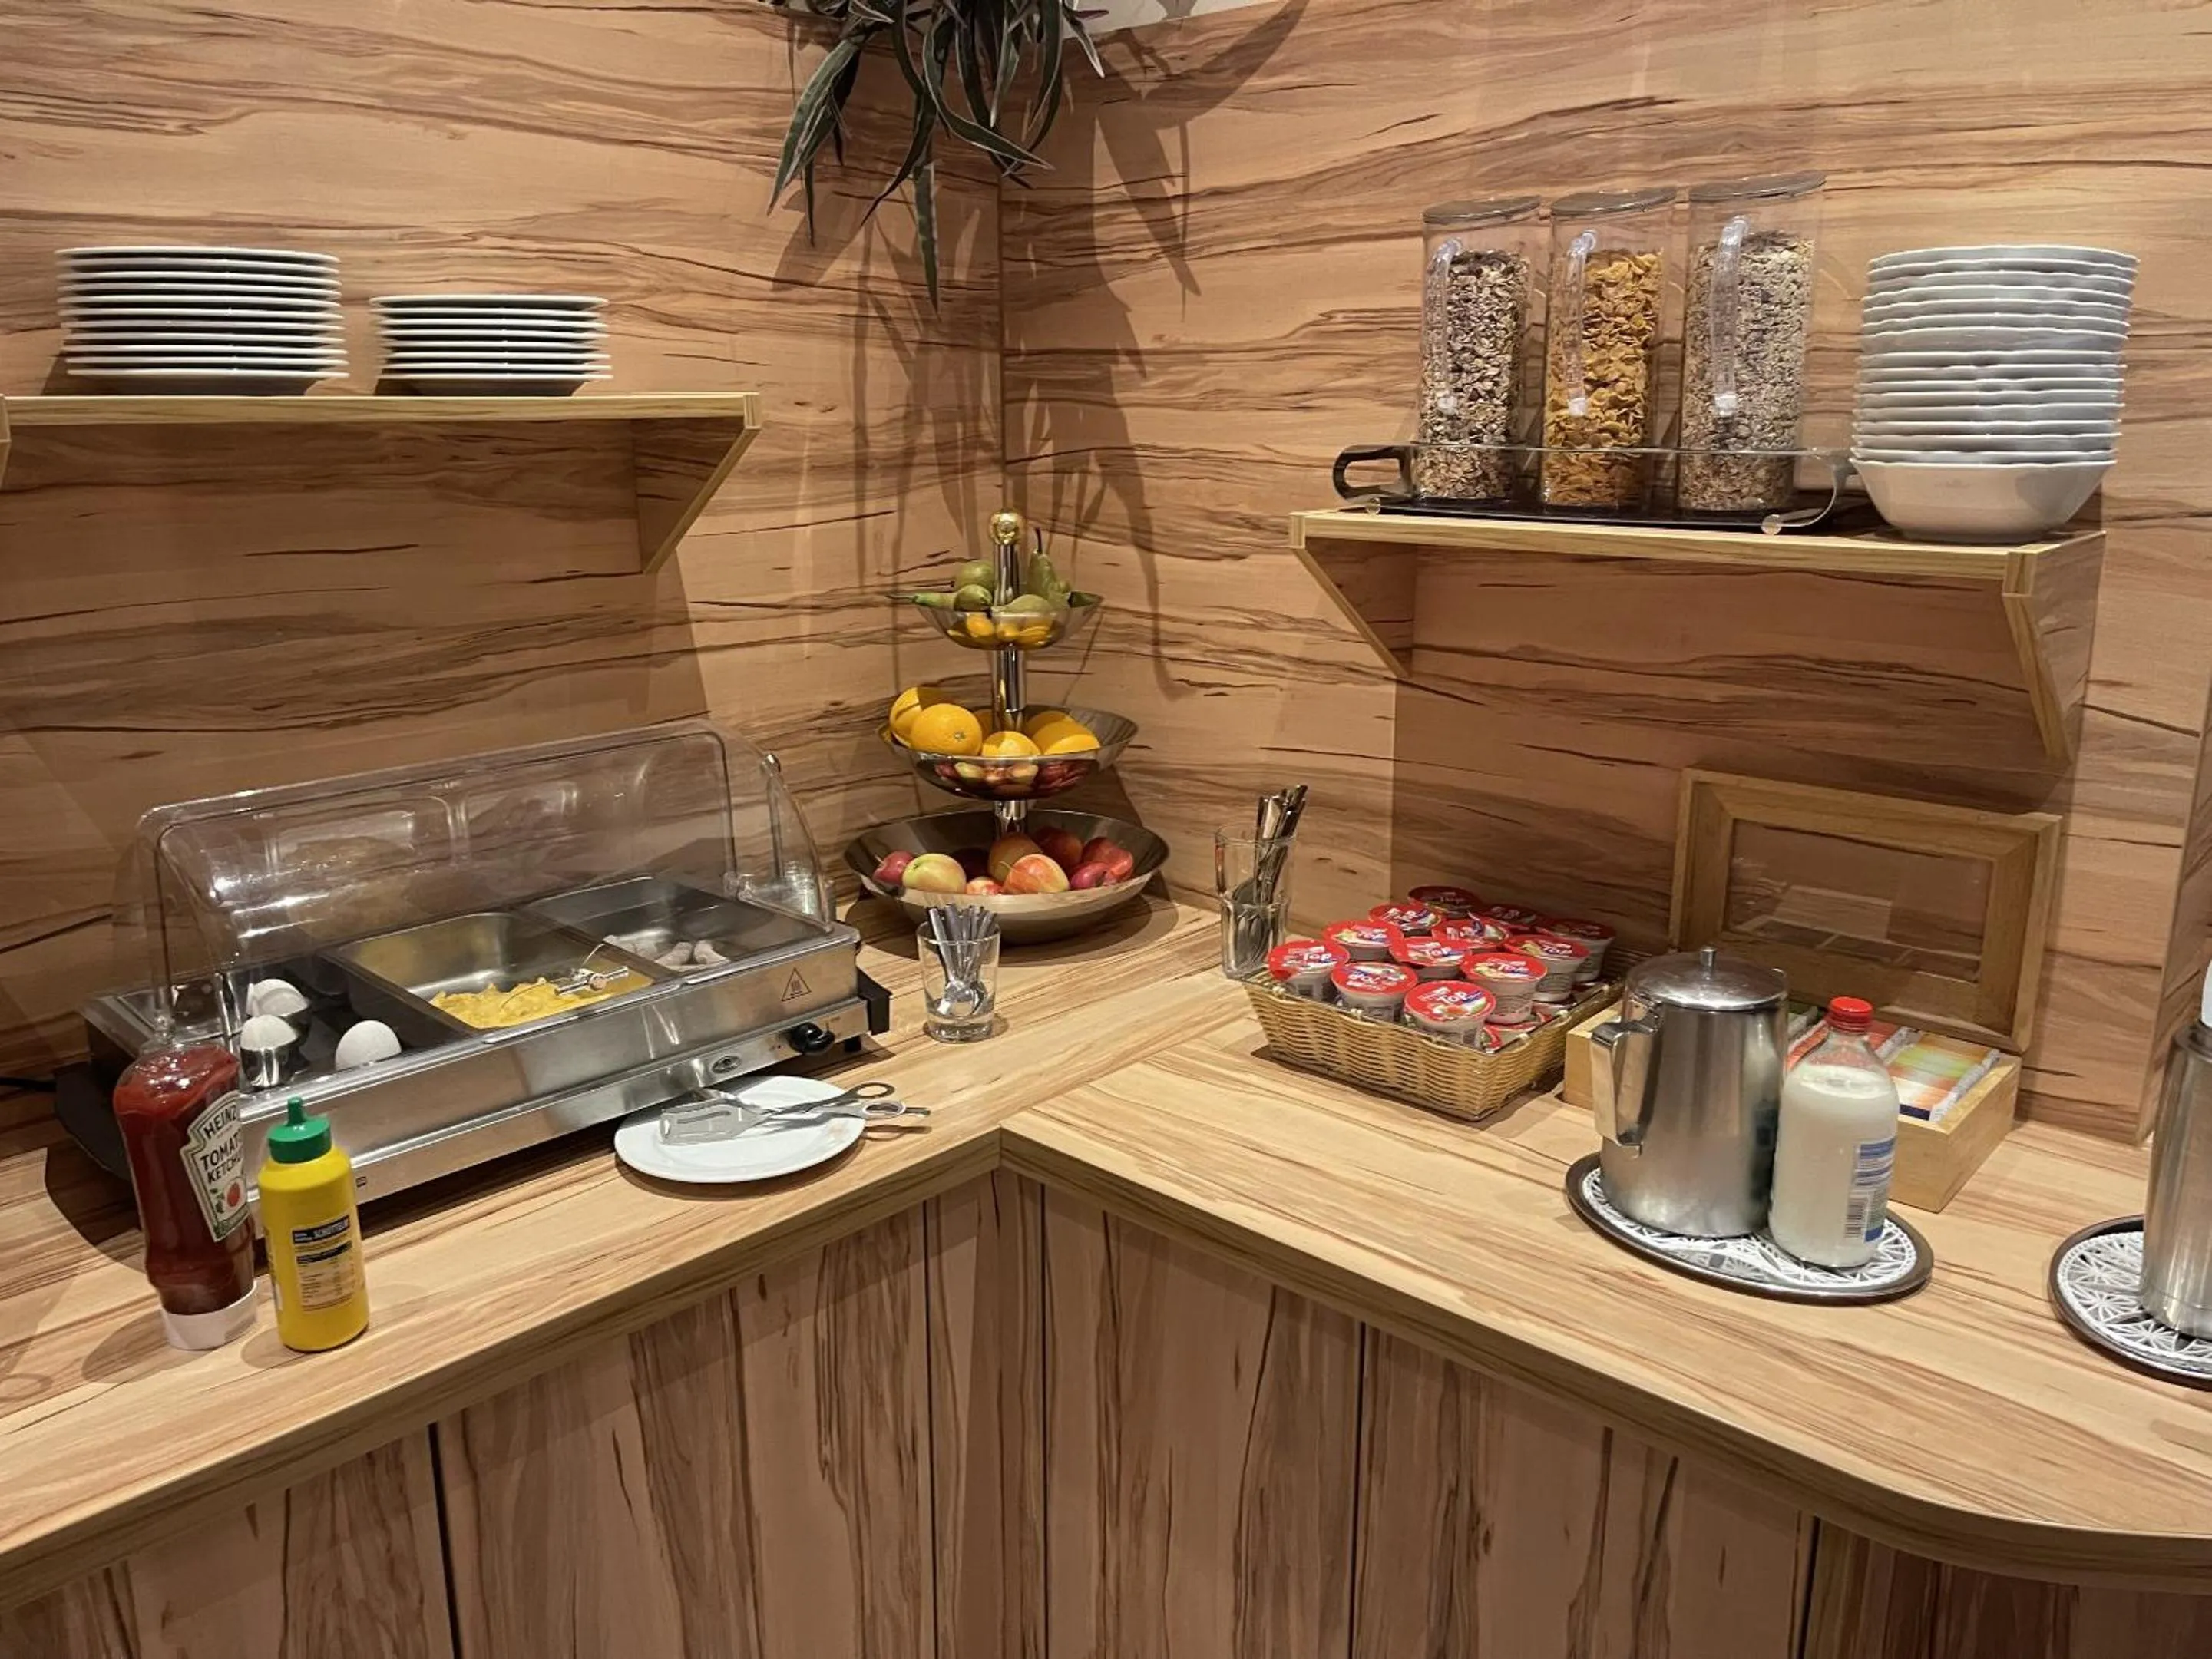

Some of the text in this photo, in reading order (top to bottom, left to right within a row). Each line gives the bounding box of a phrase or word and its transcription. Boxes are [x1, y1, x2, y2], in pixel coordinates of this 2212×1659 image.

[203, 1105, 237, 1139] HEINZ
[200, 1128, 241, 1171] TOMAT
[207, 1157, 241, 1184] KETCH
